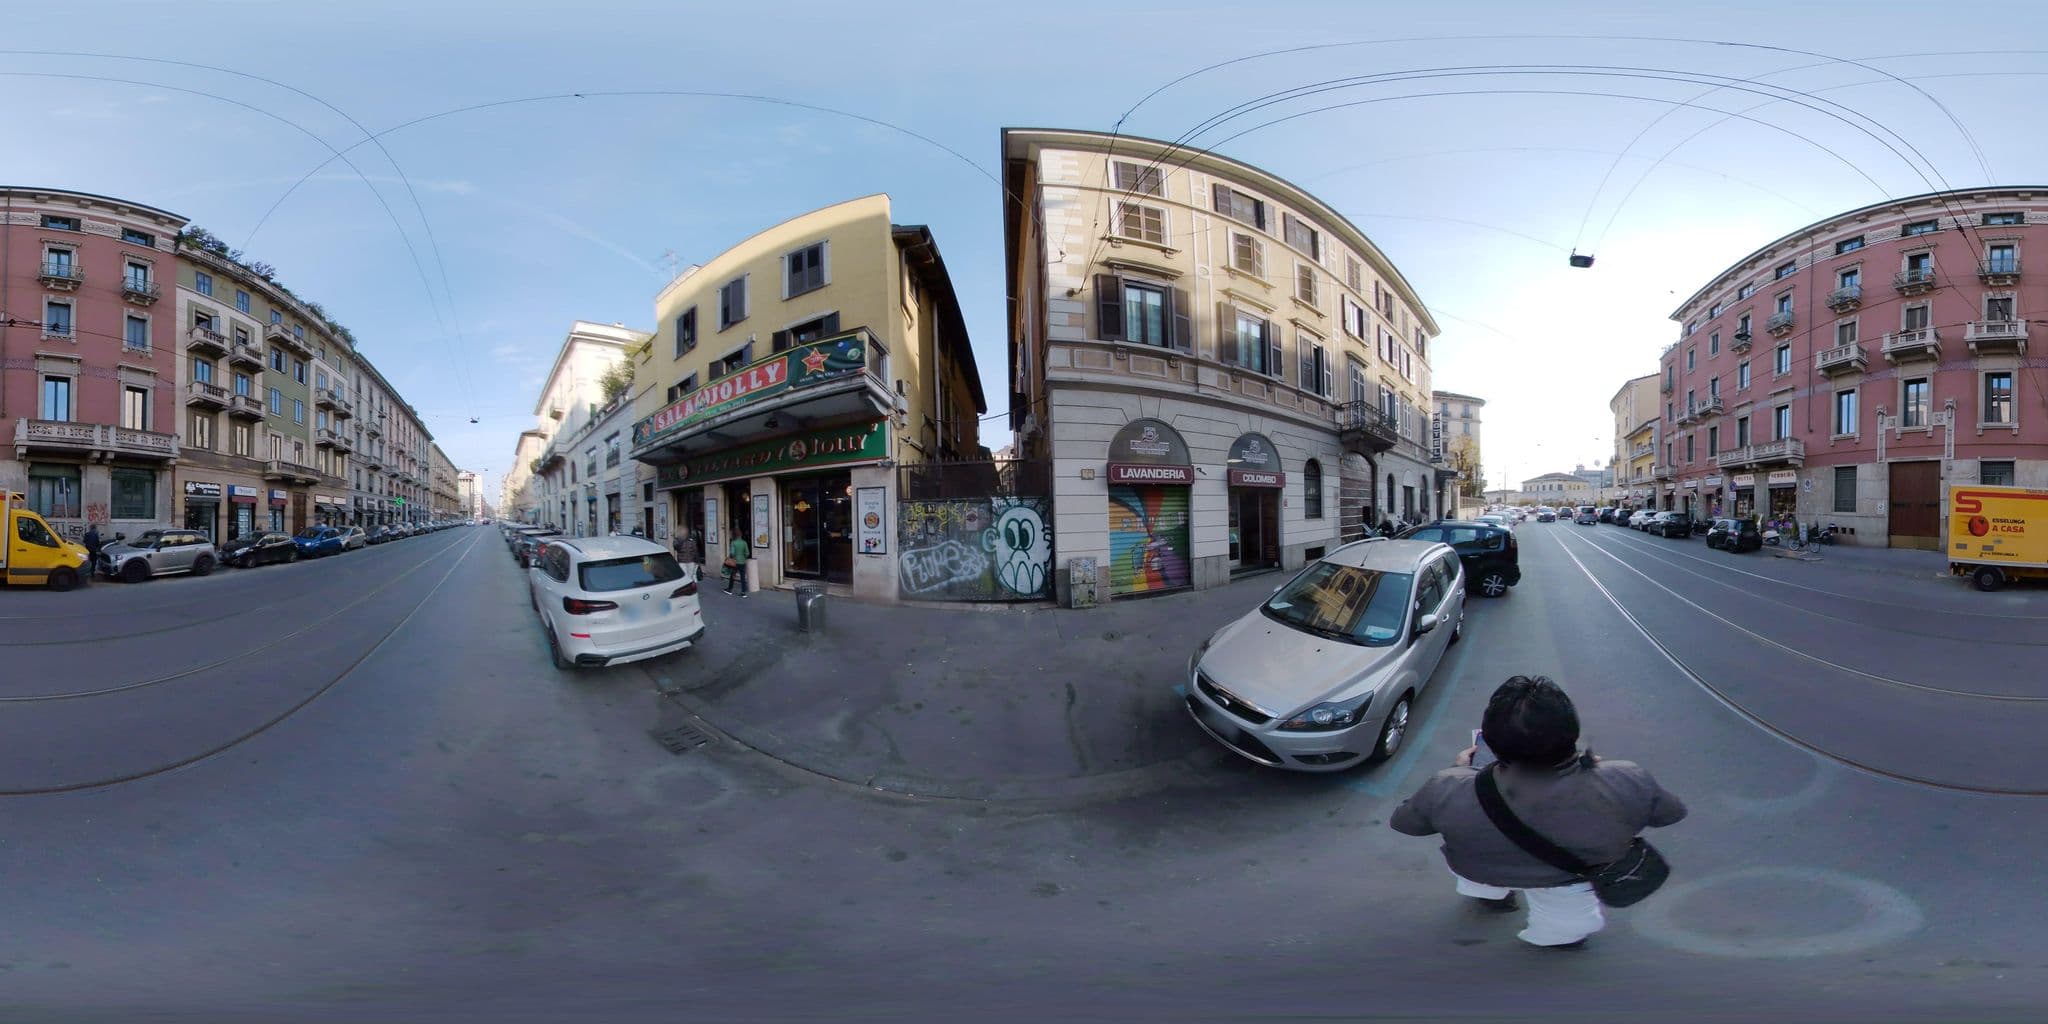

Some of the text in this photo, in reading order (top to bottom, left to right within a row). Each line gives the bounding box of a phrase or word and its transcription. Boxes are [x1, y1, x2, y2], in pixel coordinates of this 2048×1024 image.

[658, 403, 694, 429] SALA
[709, 362, 781, 405] JOLLY
[1120, 468, 1186, 480] LAVANDERIA
[1242, 473, 1276, 484] COLOMBO
[2001, 525, 2025, 533] CASA
